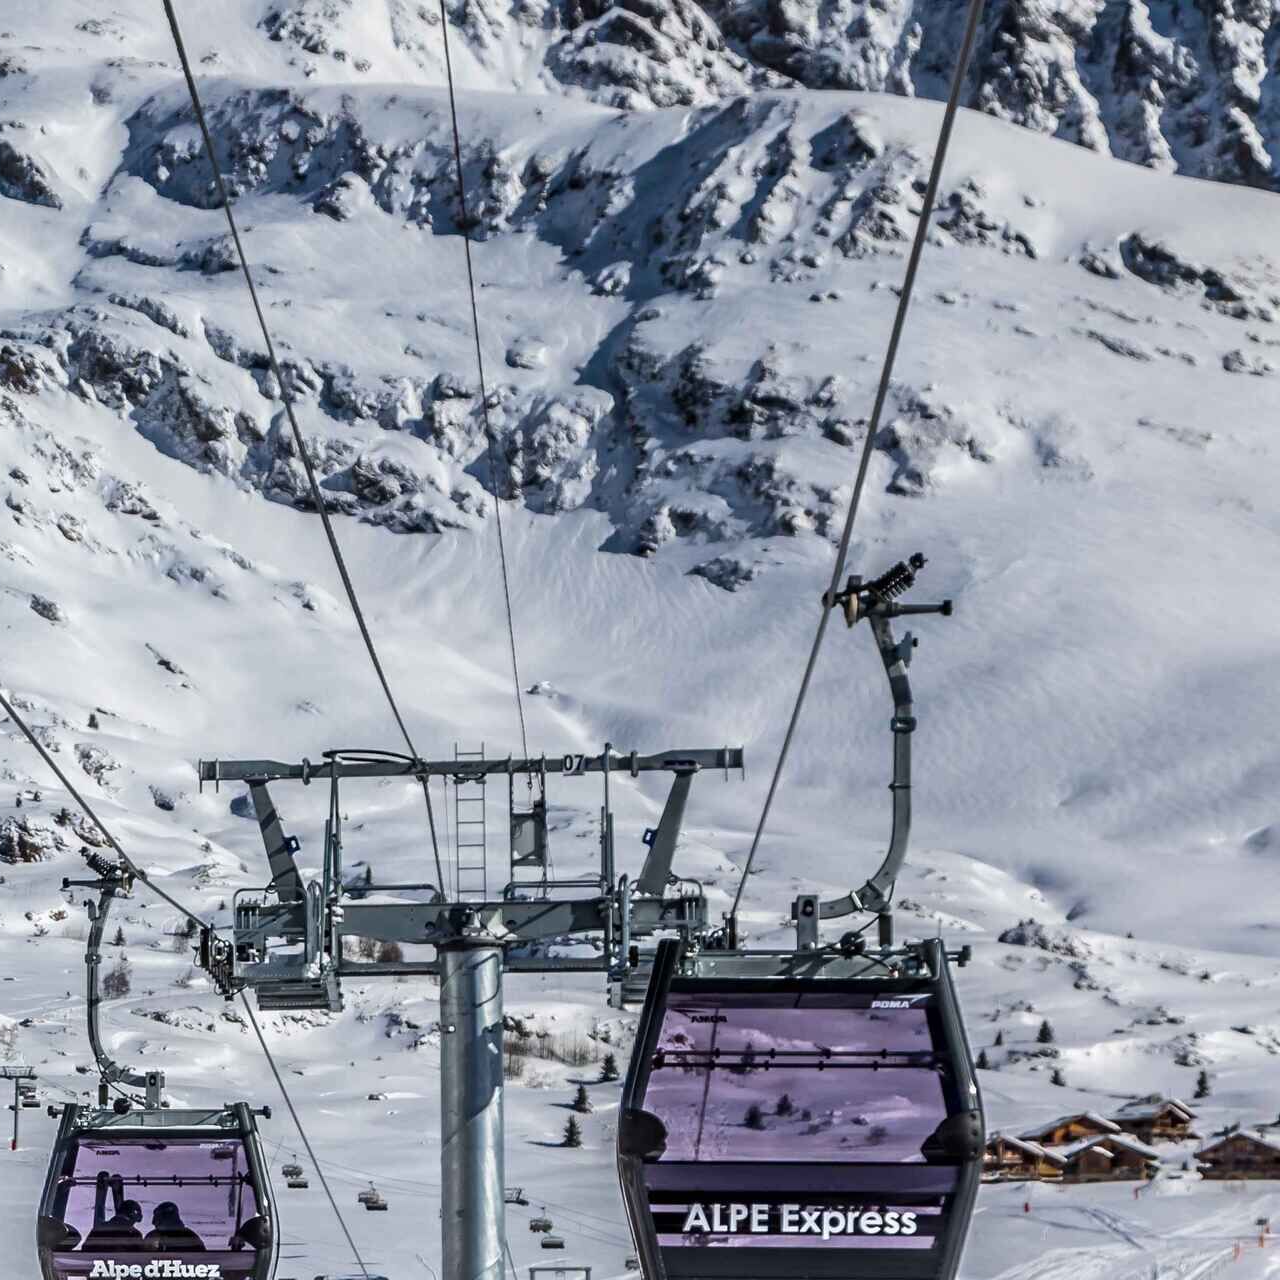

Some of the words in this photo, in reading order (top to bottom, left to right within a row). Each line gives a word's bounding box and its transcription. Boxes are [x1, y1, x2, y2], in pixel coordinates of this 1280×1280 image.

[564, 754, 584, 771] 07
[683, 1204, 769, 1232] ALPE
[781, 1203, 918, 1240] Express
[144, 1259, 221, 1279] d'Huez
